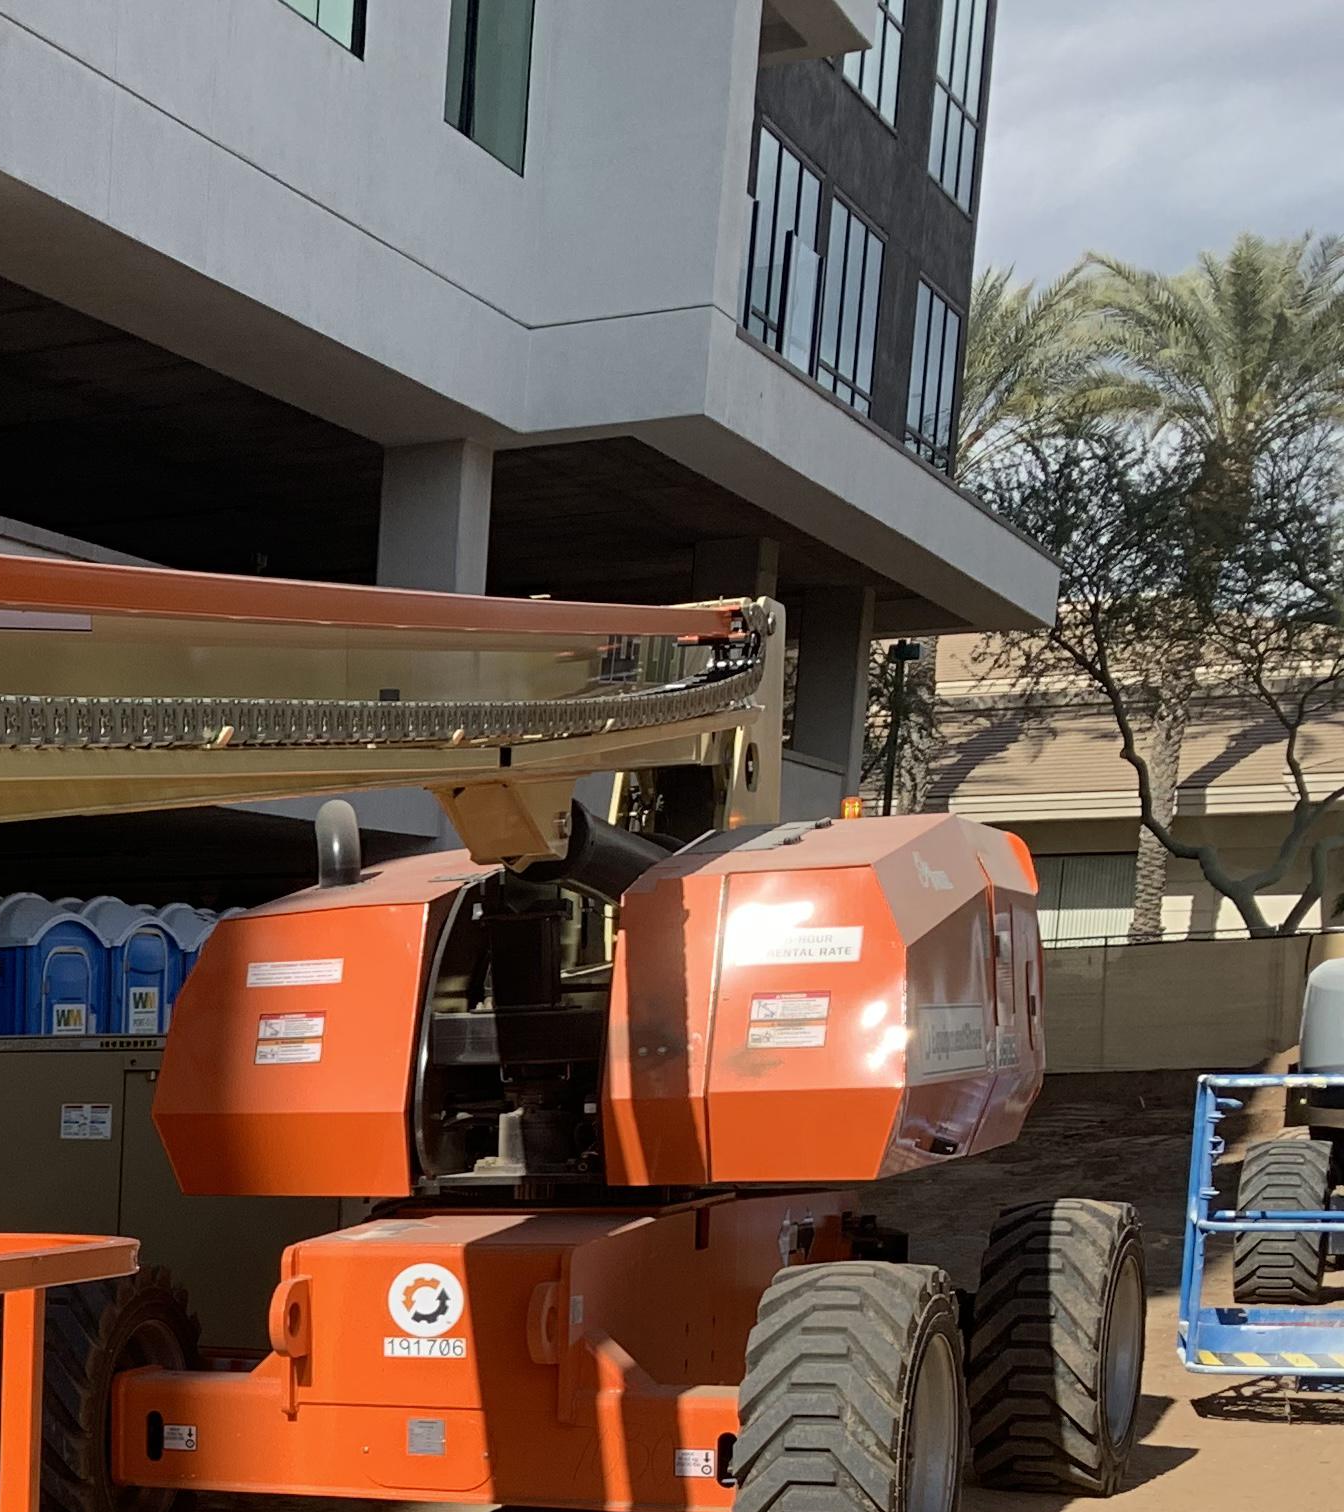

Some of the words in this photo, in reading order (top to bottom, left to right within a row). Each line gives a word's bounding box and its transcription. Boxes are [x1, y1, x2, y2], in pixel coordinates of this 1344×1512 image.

[819, 945, 853, 957] RATE
[56, 1009, 82, 1026] WM
[387, 1339, 464, 1357] 191706
